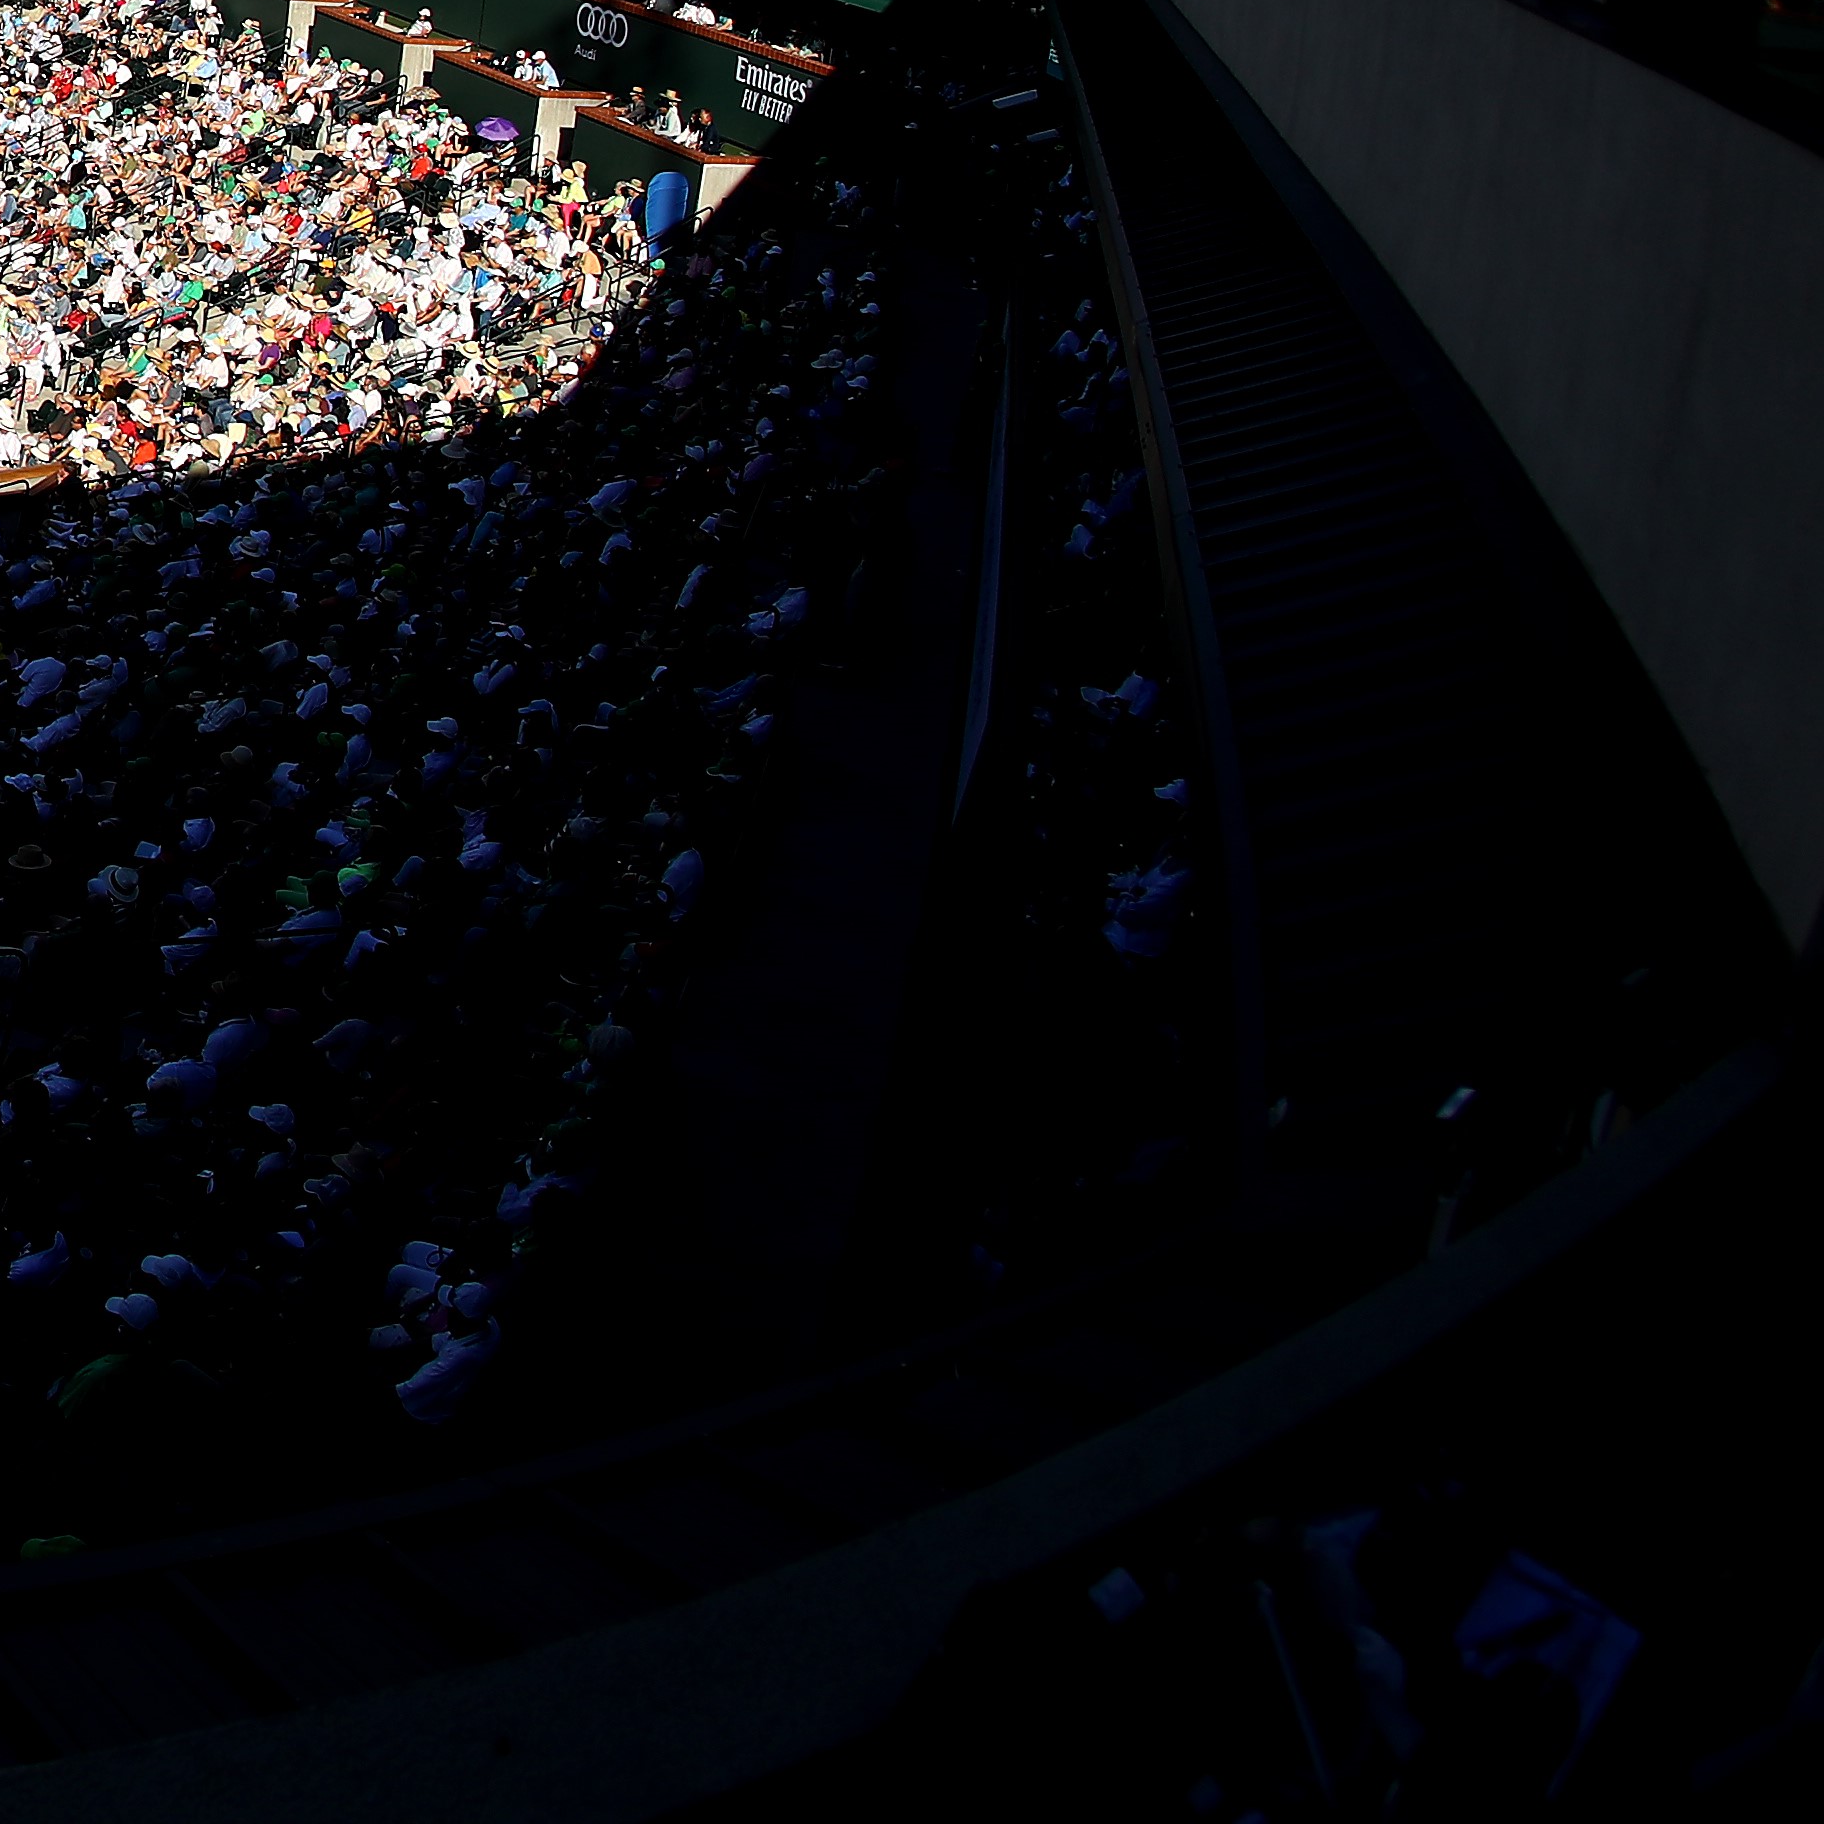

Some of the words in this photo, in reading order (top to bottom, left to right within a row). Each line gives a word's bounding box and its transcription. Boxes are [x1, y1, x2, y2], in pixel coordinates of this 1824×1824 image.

[573, 43, 598, 62] Audi
[740, 88, 759, 112] FLY
[758, 93, 794, 125] BETTER
